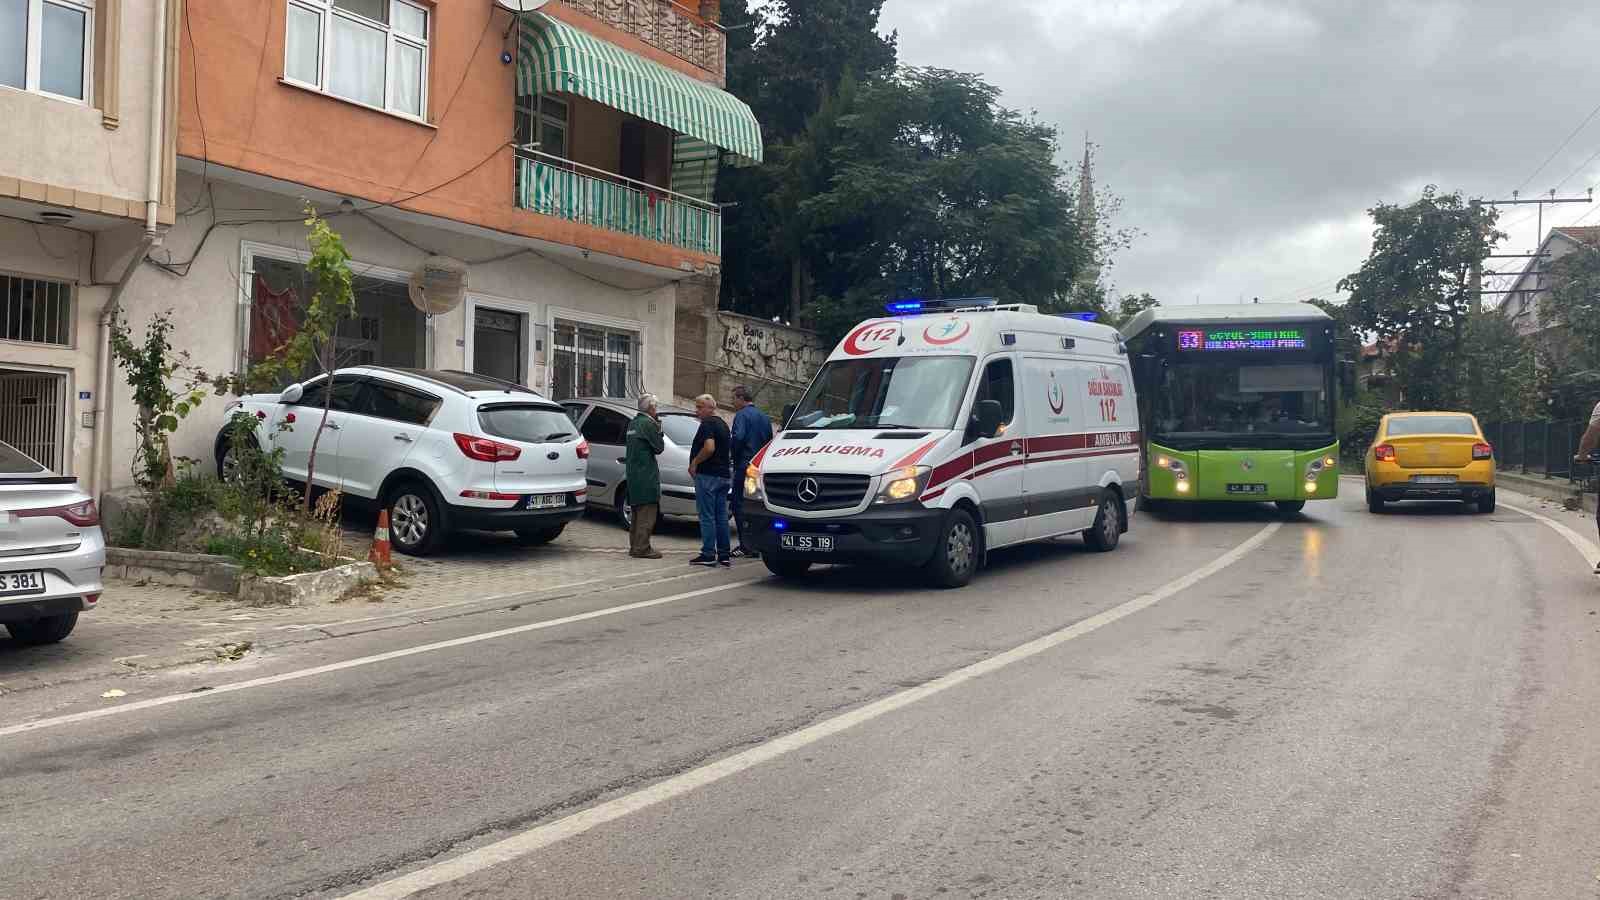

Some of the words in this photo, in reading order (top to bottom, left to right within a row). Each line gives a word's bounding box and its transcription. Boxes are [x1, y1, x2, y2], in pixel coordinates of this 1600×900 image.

[862, 328, 897, 342] 112
[1099, 398, 1117, 422] 112
[1094, 431, 1132, 447] AMBULANS
[783, 535, 794, 546] 41
[799, 536, 812, 547] SS
[817, 537, 831, 548] 119
[12, 573, 39, 589] 381
